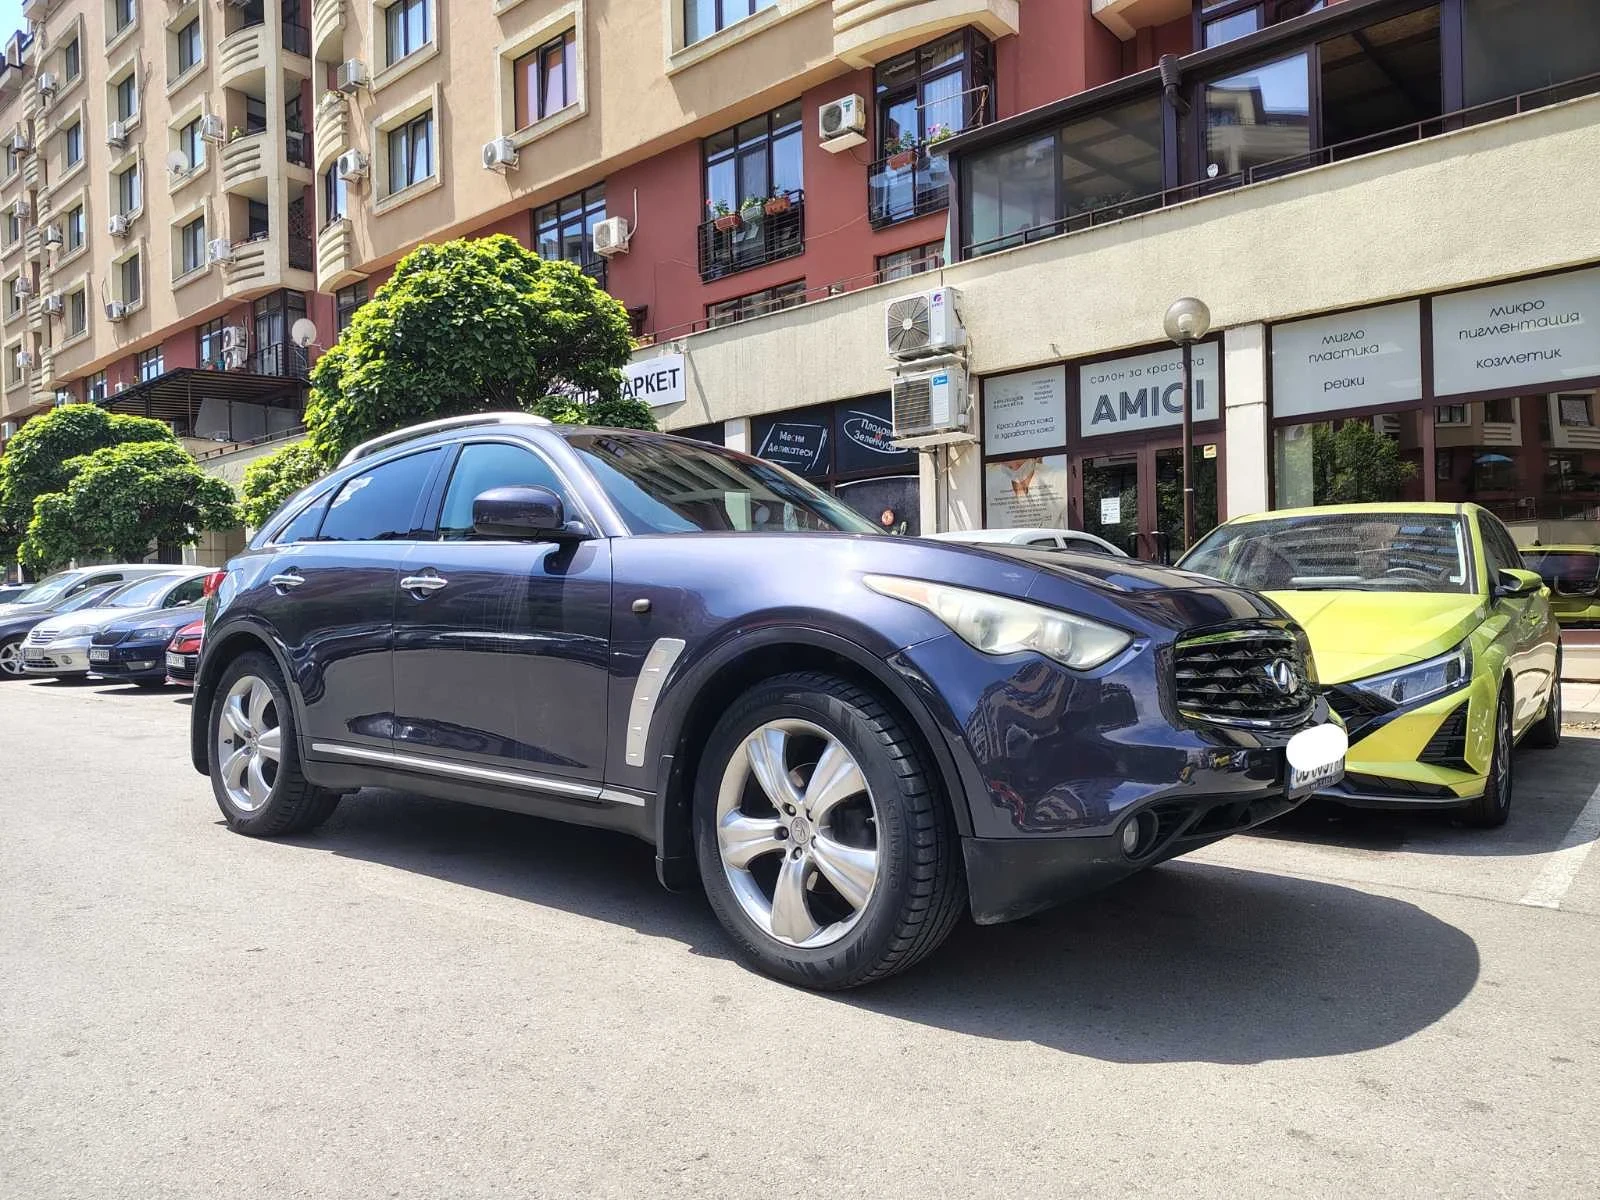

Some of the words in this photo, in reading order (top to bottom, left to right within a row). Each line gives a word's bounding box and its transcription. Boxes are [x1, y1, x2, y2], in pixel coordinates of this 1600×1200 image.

[1489, 300, 1545, 318] микро
[1459, 312, 1580, 341] пигментация
[1321, 329, 1365, 345] мигло
[1308, 344, 1379, 364] пластика
[1476, 348, 1562, 369] козметик
[1090, 373, 1125, 385] салон
[1128, 369, 1142, 378] за
[1324, 376, 1365, 393] рейки
[1091, 379, 1205, 425] AMICI
